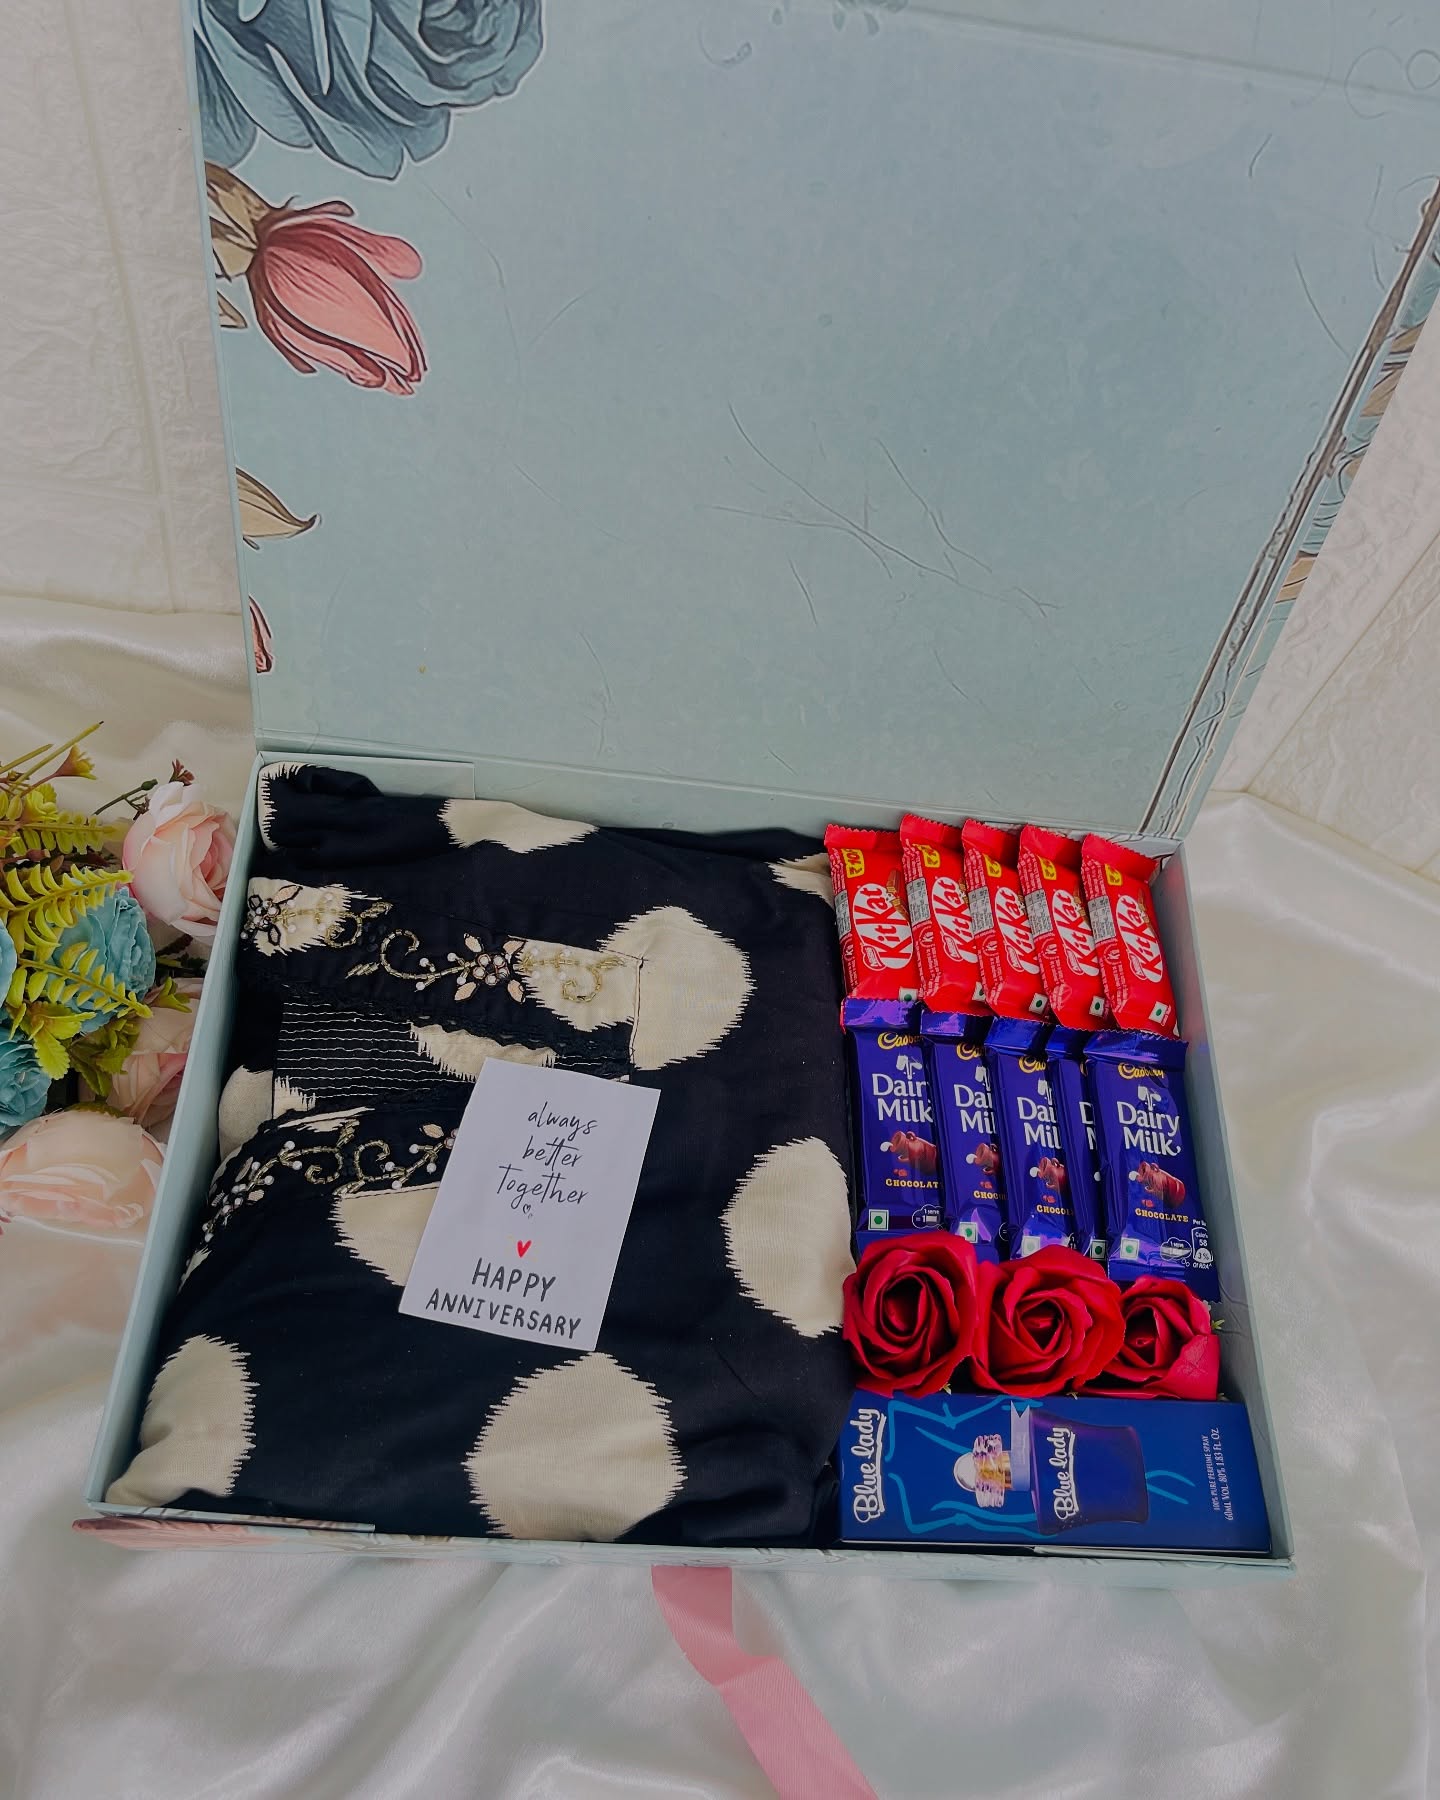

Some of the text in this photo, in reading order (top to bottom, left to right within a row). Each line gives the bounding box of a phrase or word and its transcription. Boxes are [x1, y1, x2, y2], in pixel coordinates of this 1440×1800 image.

[871, 1073, 931, 1098] Dair
[953, 1083, 993, 1109] Dai
[528, 1101, 599, 1141] always
[878, 1098, 934, 1123] Milk
[960, 1109, 996, 1135] Mil
[1016, 1096, 1058, 1123] Dai
[1116, 1101, 1180, 1137] Dairy
[1023, 1123, 1062, 1149] Mil
[1123, 1127, 1182, 1156] Milk
[522, 1136, 584, 1171] better
[885, 1178, 940, 1189] CHOCOLAT
[1135, 1208, 1189, 1223] CHOCOLATE
[471, 1257, 556, 1302] HAPPY
[425, 1287, 582, 1340] ANNIVERSARY
[1201, 1435, 1211, 1452] SPRAY
[850, 1408, 881, 1523] Blue lady
[1046, 1427, 1076, 1520] Blue lady
[1204, 1453, 1215, 1480] PERFUME
[1209, 1480, 1218, 1496] PURE
